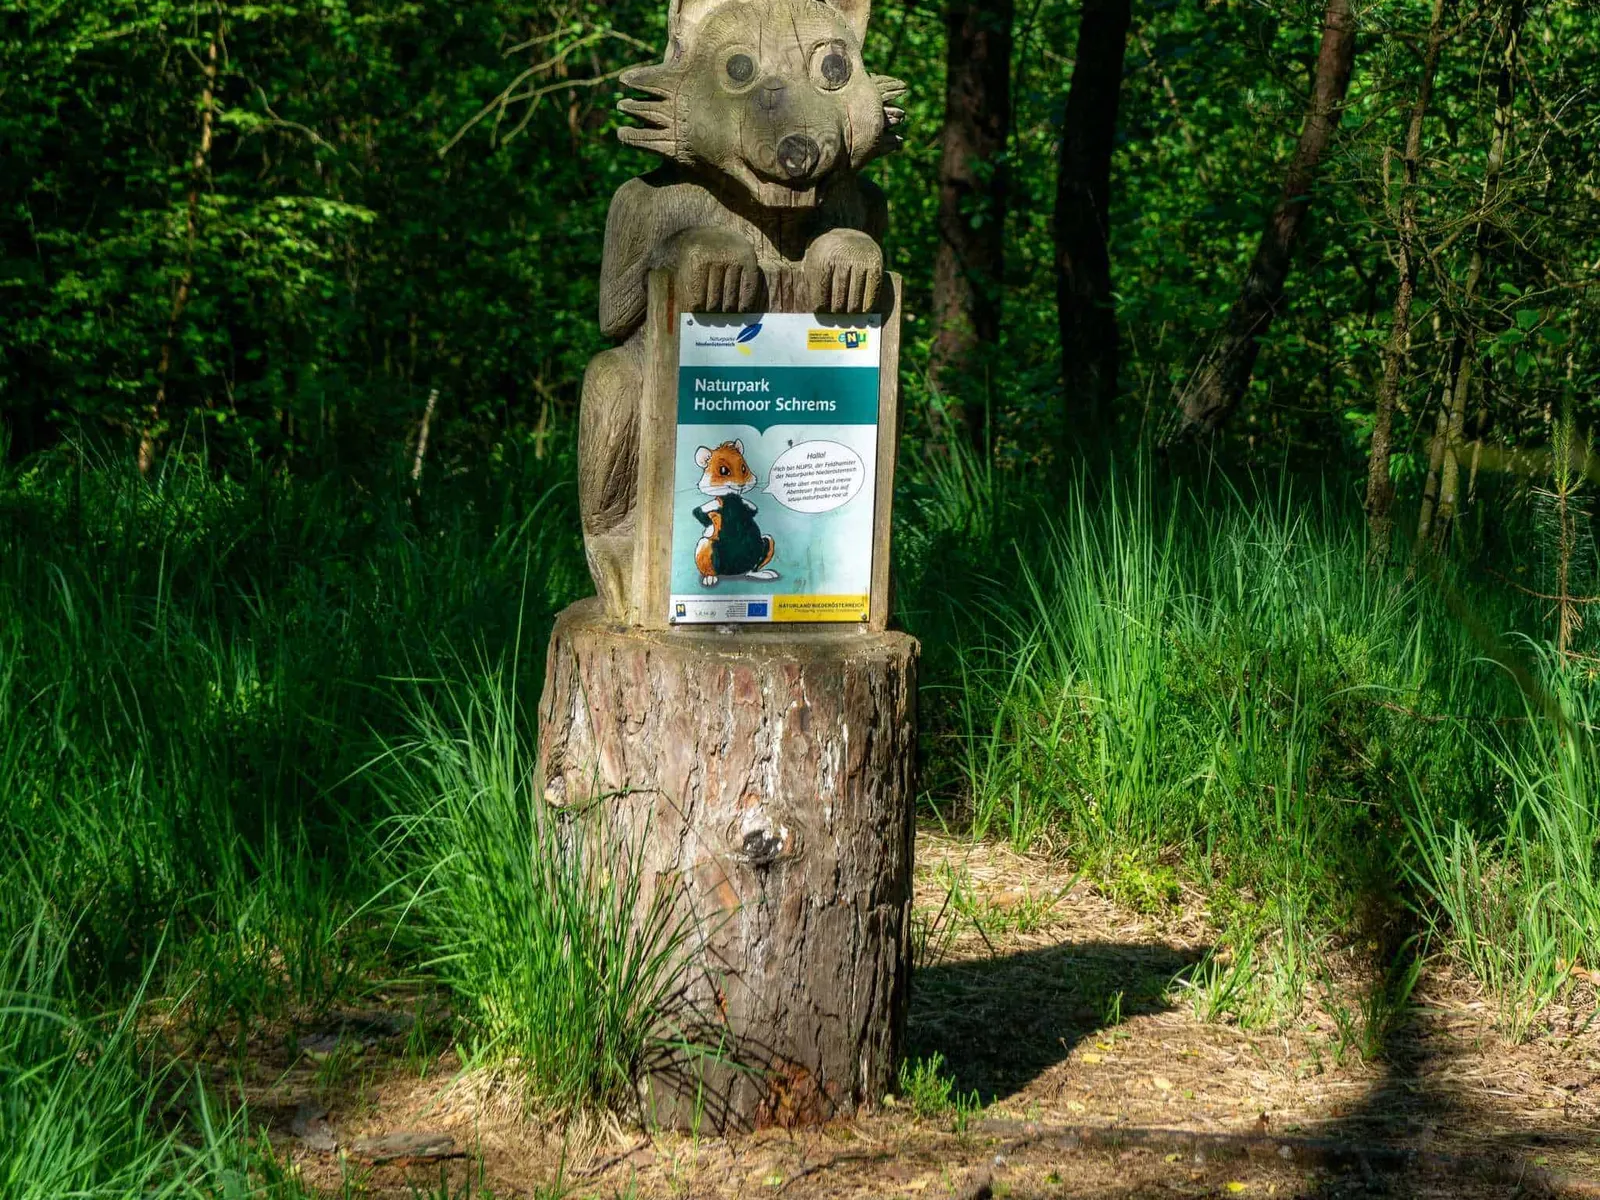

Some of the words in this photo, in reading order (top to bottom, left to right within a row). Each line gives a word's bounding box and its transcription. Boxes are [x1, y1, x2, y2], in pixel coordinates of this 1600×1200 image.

[694, 378, 770, 395] Naturpark
[694, 397, 771, 411] Hochmoor
[775, 397, 837, 411] Schrems
[806, 451, 827, 460] Hallo!
